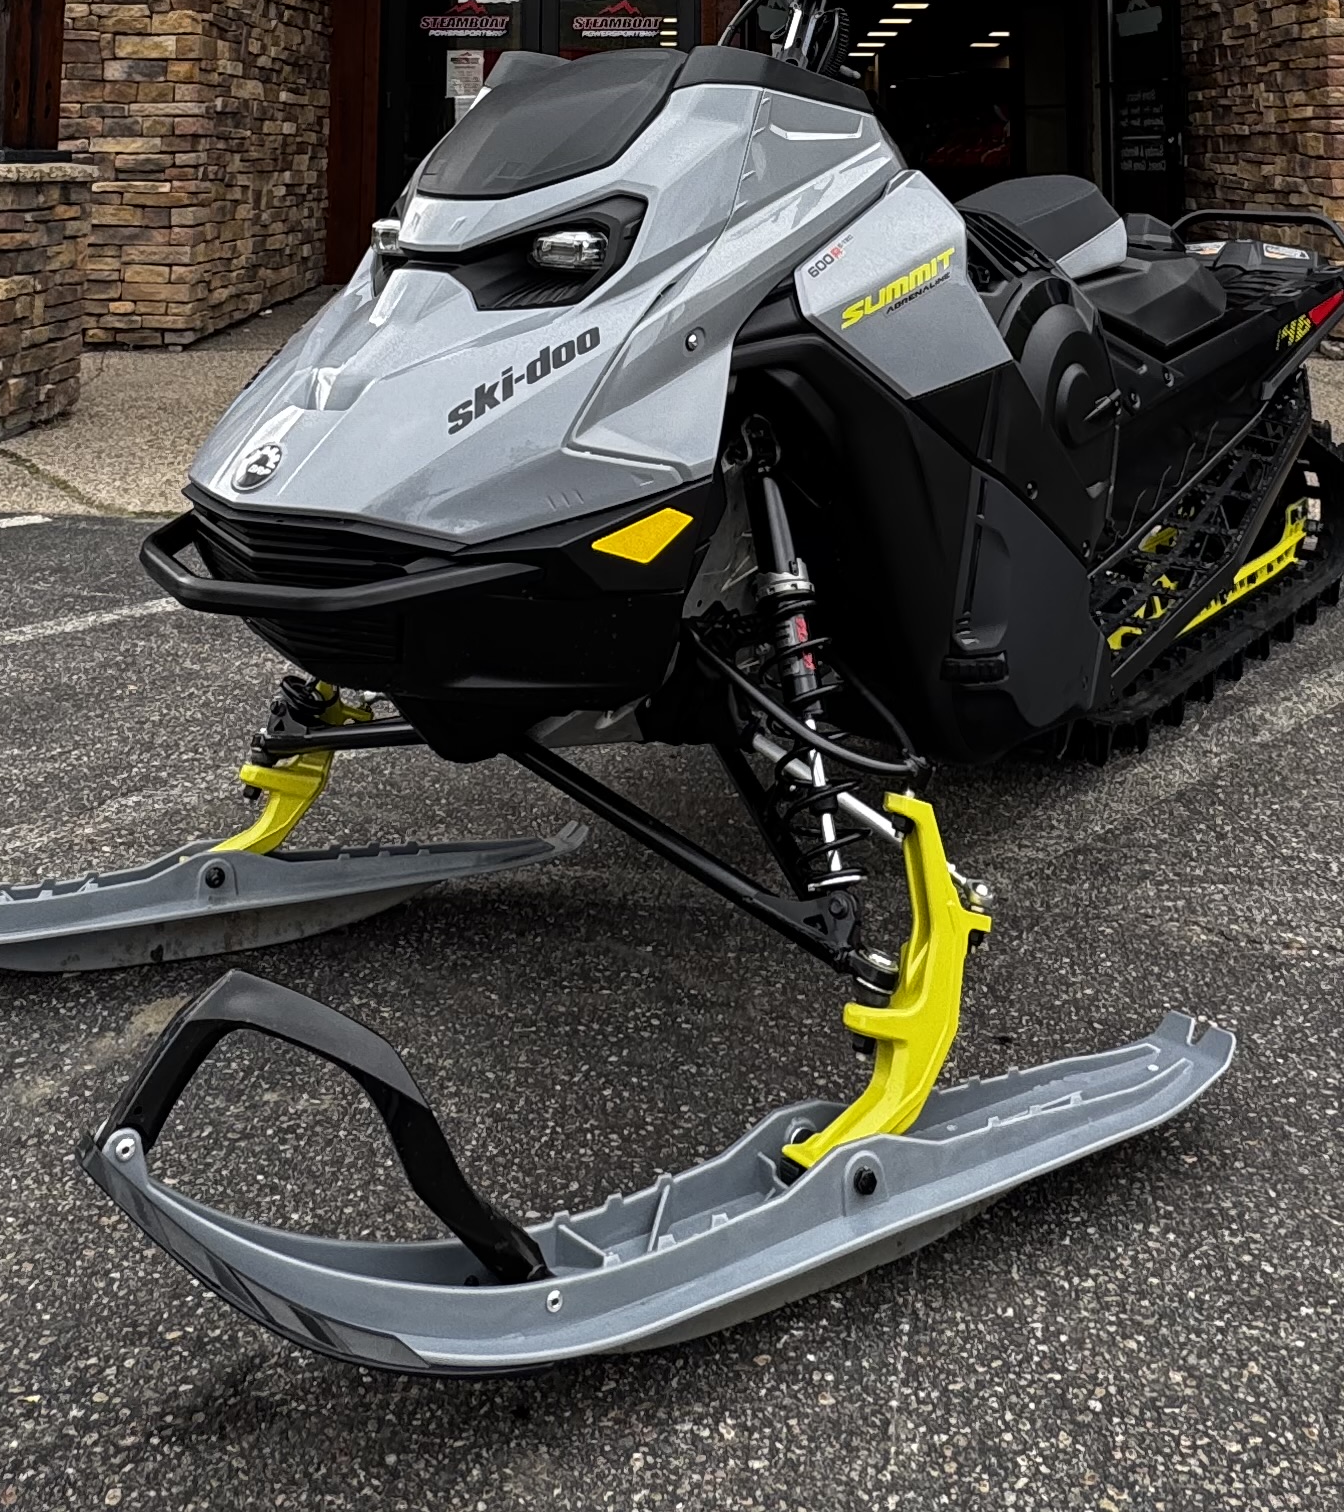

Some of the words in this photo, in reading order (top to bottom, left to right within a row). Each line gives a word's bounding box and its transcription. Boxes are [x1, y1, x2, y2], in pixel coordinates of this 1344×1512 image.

[420, 15, 509, 30] STEAMBOAT
[573, 16, 663, 31] STEAMBOAT
[840, 246, 956, 331] SUMMIT
[886, 271, 952, 315] ADRENALINE
